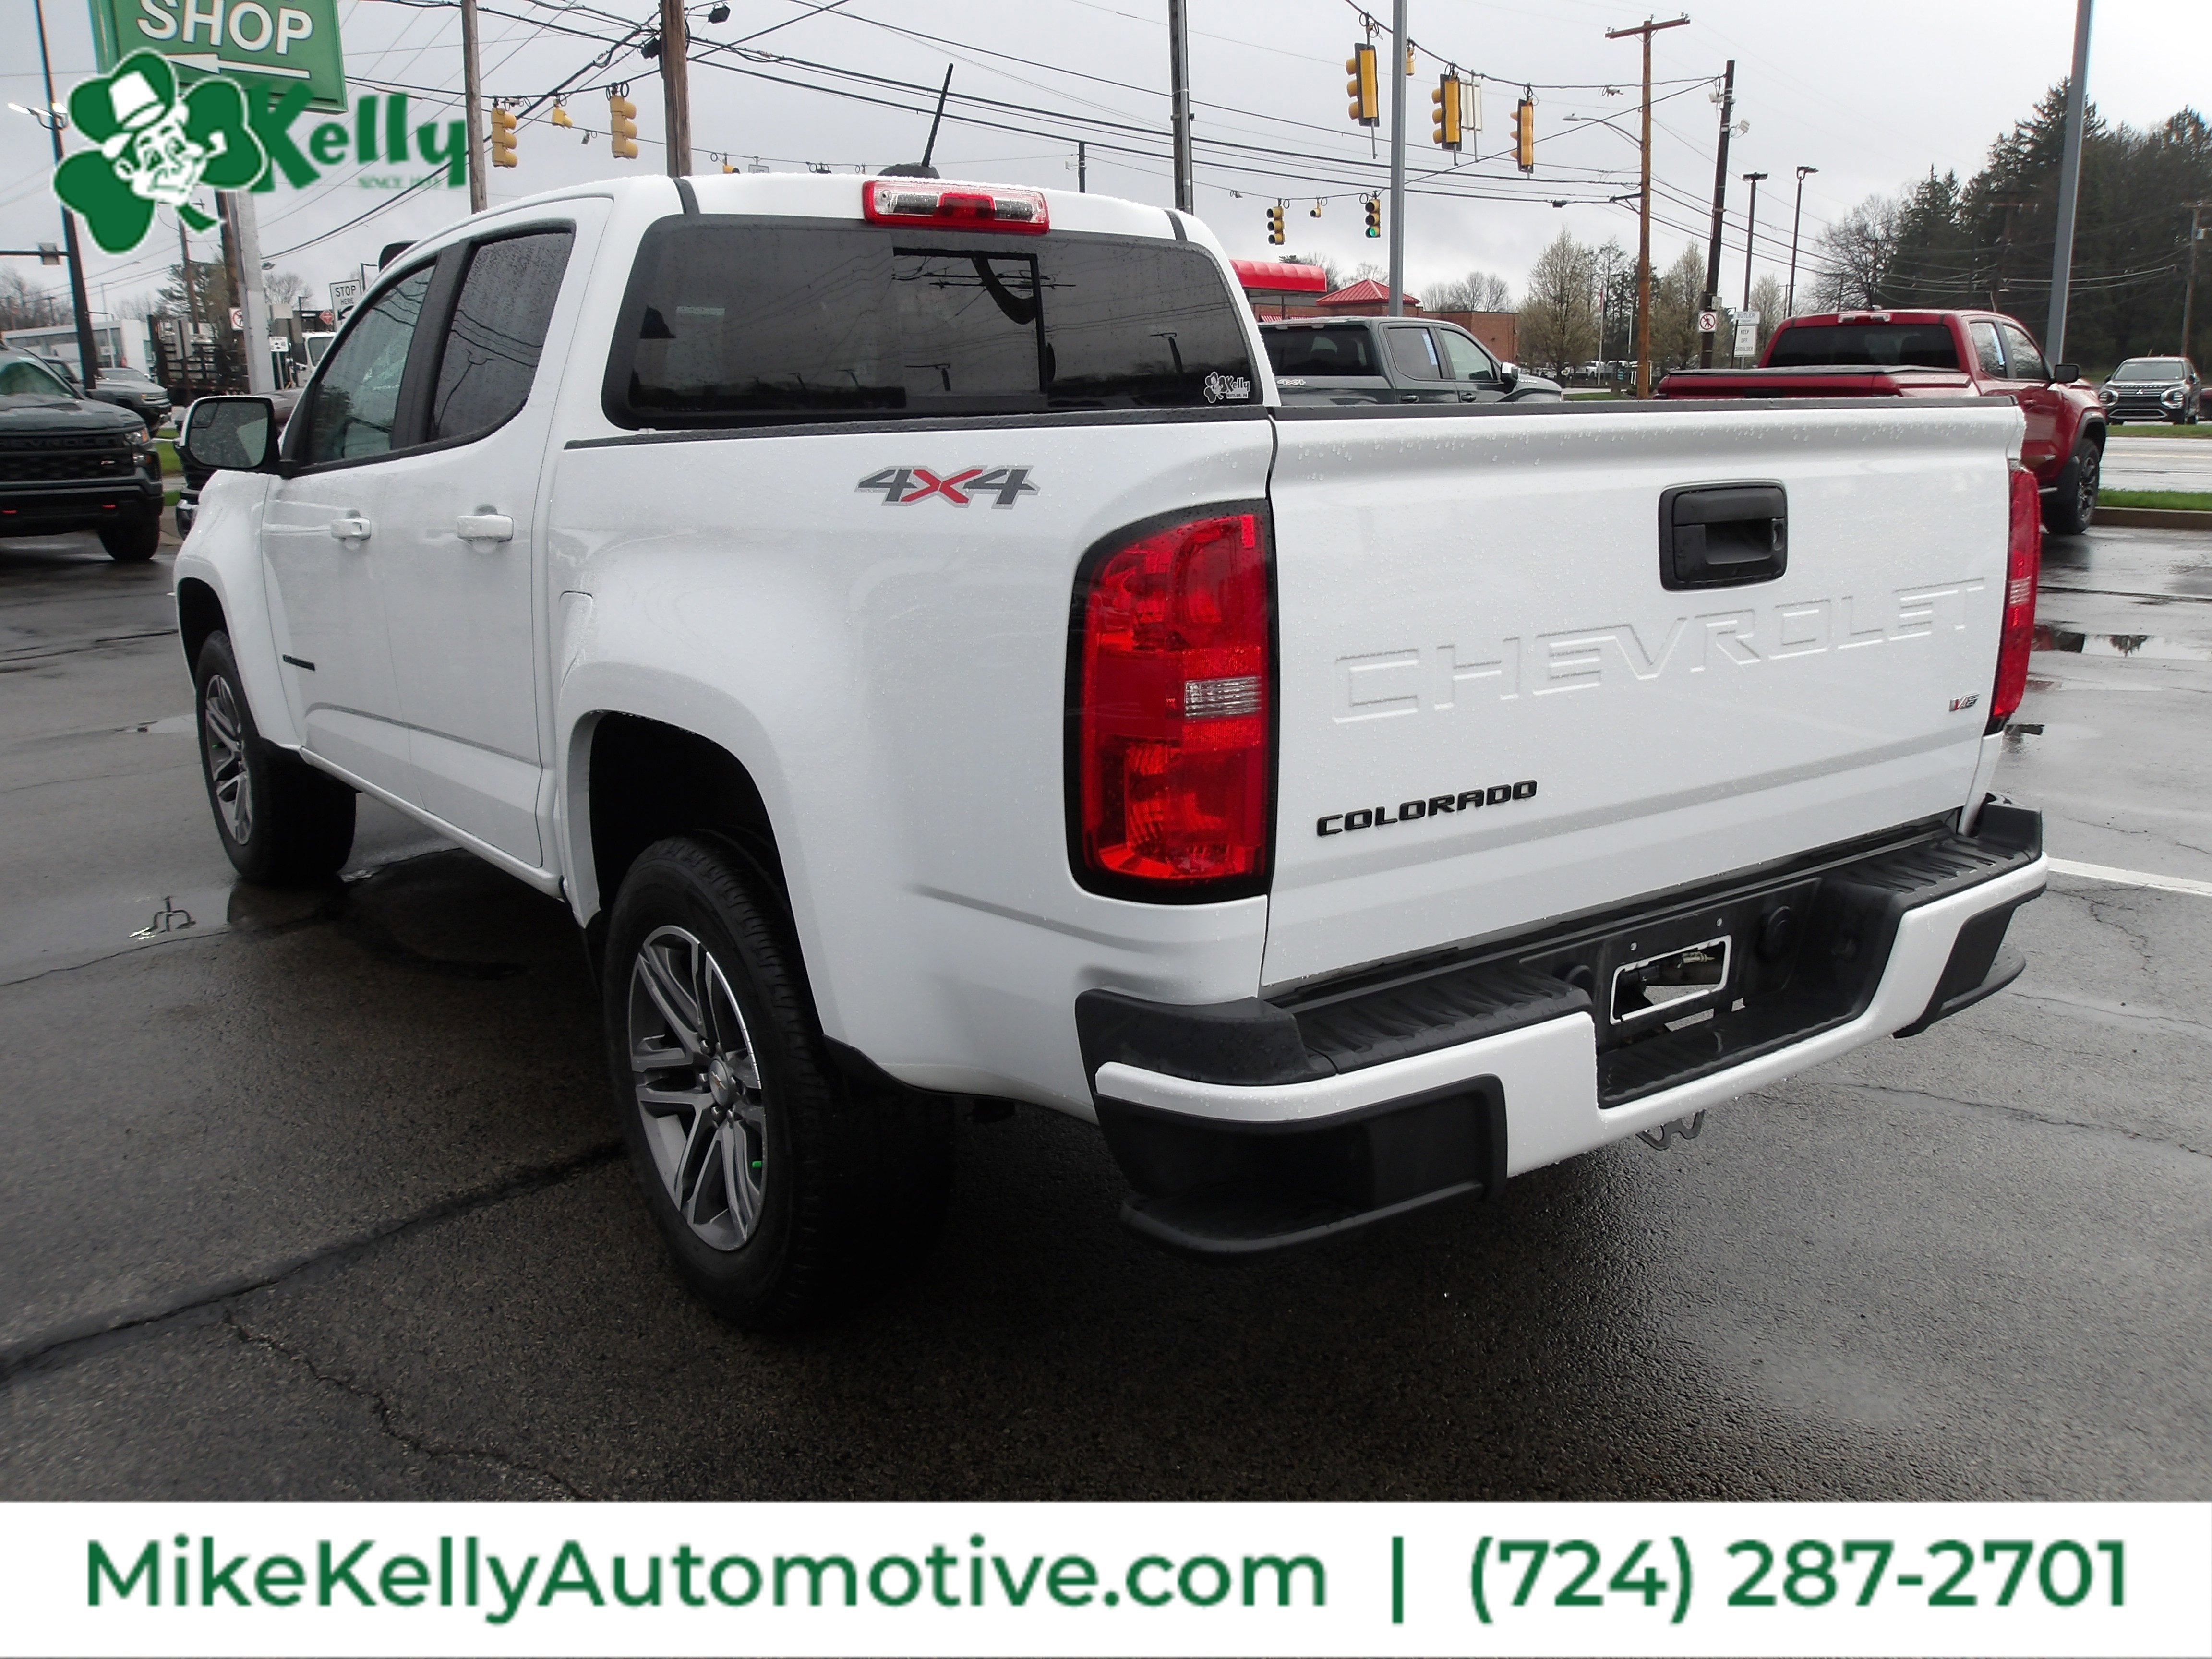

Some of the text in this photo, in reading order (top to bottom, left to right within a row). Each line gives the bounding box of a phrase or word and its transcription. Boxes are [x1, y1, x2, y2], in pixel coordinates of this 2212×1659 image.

[136, 0, 313, 55] SHOP
[335, 285, 356, 297] STOP
[1225, 375, 1250, 392] Kelly
[1334, 577, 1984, 723] CHEVROLET
[1317, 780, 1538, 836] COLORADO
